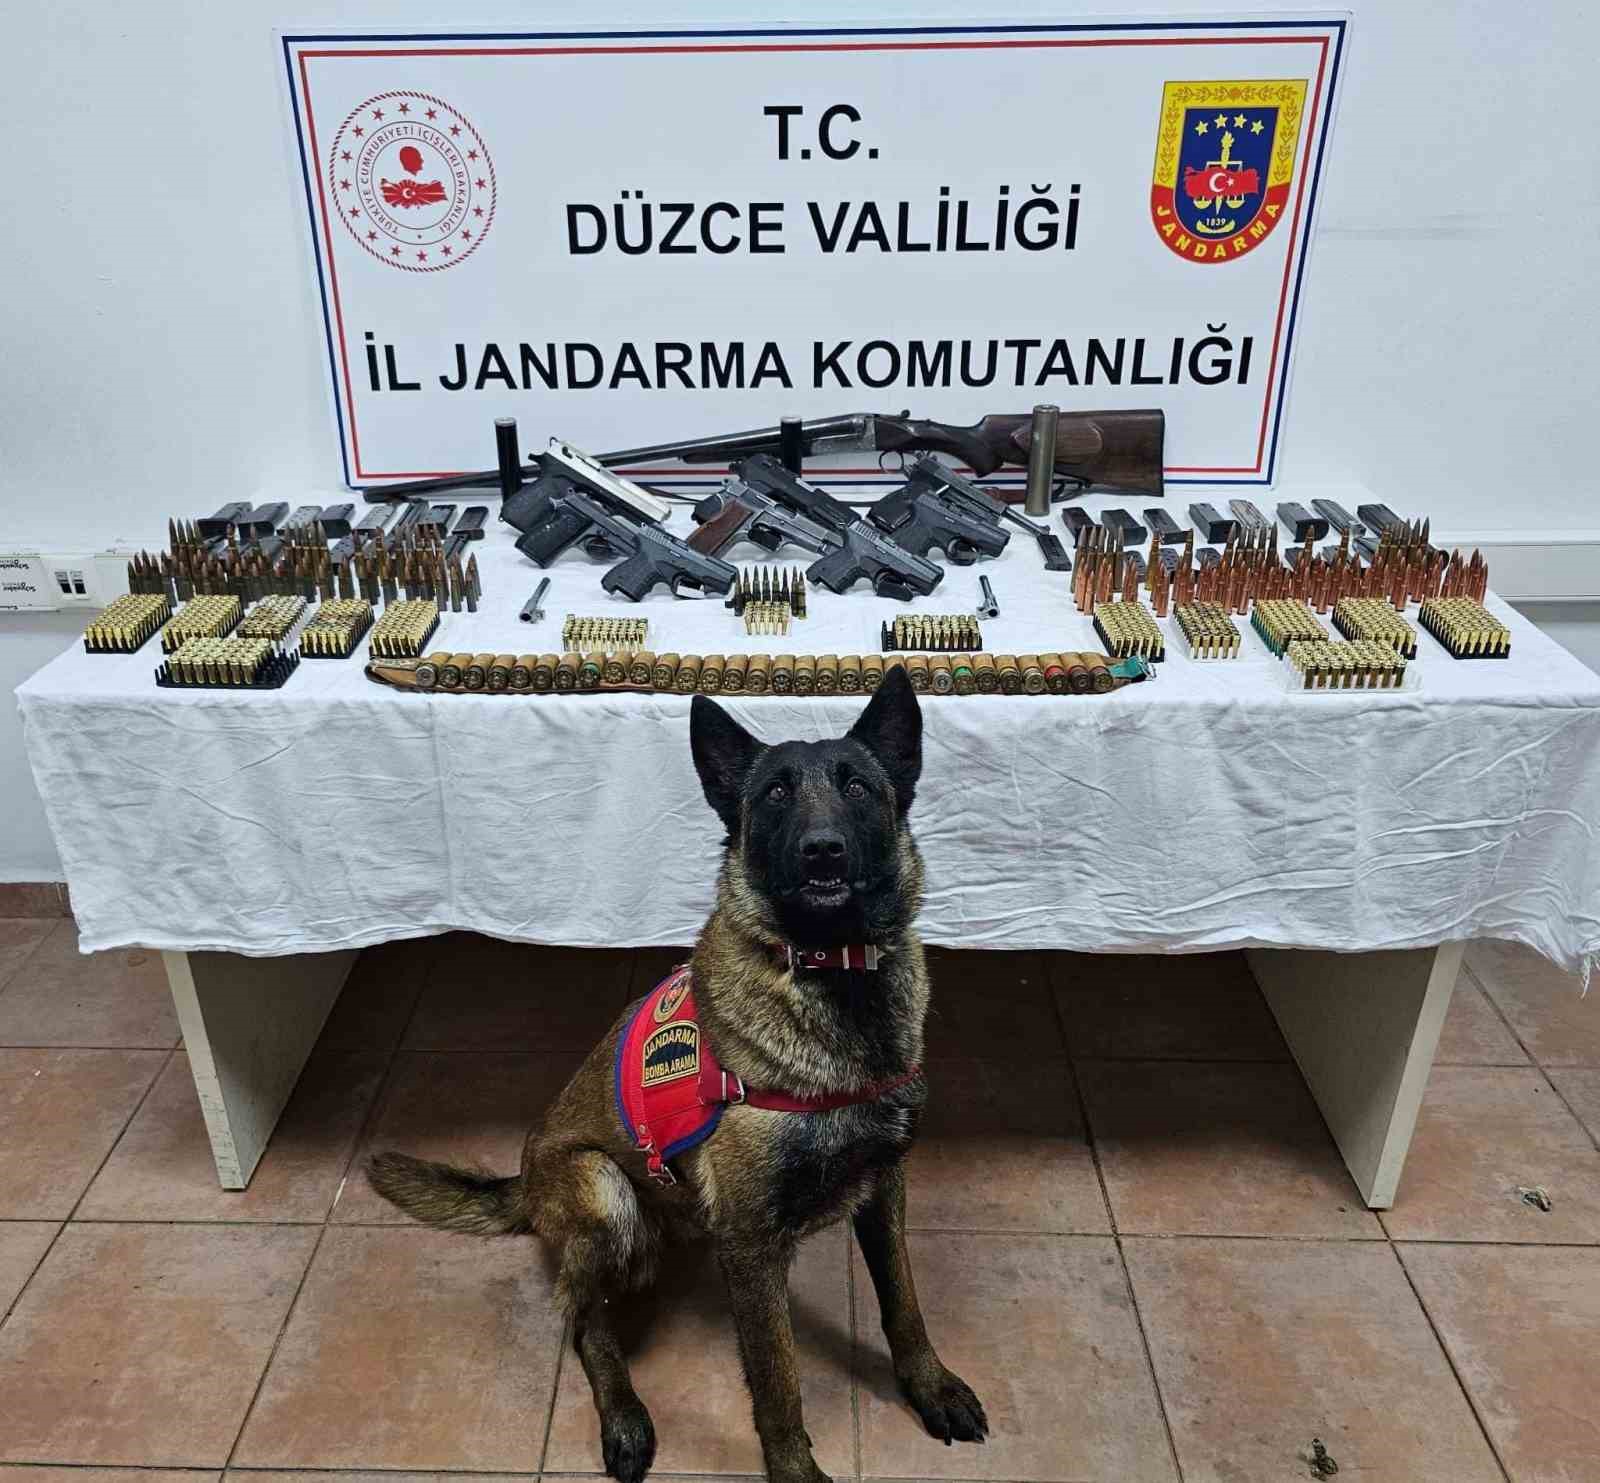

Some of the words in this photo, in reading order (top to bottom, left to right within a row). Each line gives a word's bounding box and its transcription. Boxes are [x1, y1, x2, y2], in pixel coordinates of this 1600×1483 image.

[763, 104, 879, 160] T.C.
[566, 190, 785, 255] DÜZCE
[807, 183, 1081, 254] VALİLİĞİ
[1157, 204, 1280, 258] JANDARMA
[1206, 217, 1227, 227] 1839
[364, 331, 421, 391] İL
[439, 341, 793, 391] JANDARMA
[813, 323, 1254, 389] KOMUTANLIĞI
[645, 1028, 696, 1059] JANDARMA
[645, 1062, 670, 1079] BOMBA
[671, 1054, 696, 1072] ARAMA
